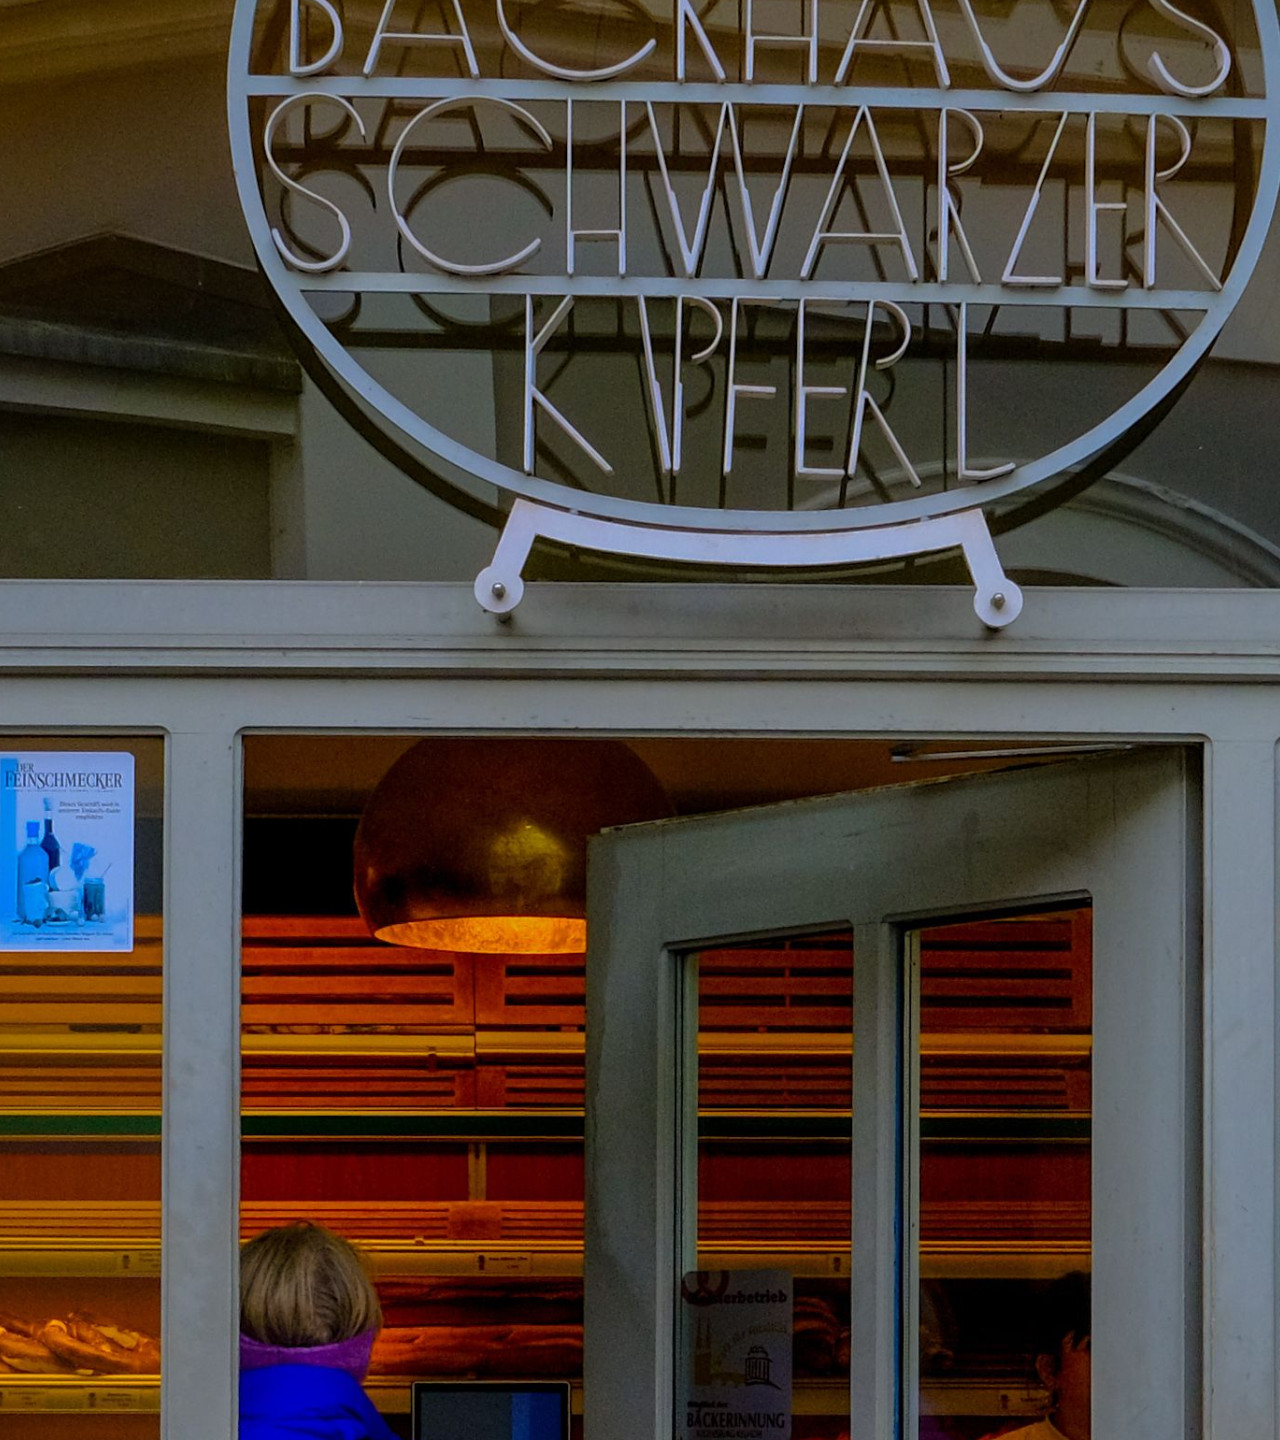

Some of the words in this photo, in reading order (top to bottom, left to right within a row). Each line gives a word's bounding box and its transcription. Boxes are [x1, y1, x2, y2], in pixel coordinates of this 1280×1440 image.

[263, 90, 1223, 293] SCHWARZER
[523, 293, 1017, 488] KIPFERL
[15, 762, 35, 773] DER
[5, 772, 123, 790] FEINSCHMECKER
[686, 1410, 785, 1429] BÄCKERINNUNG
